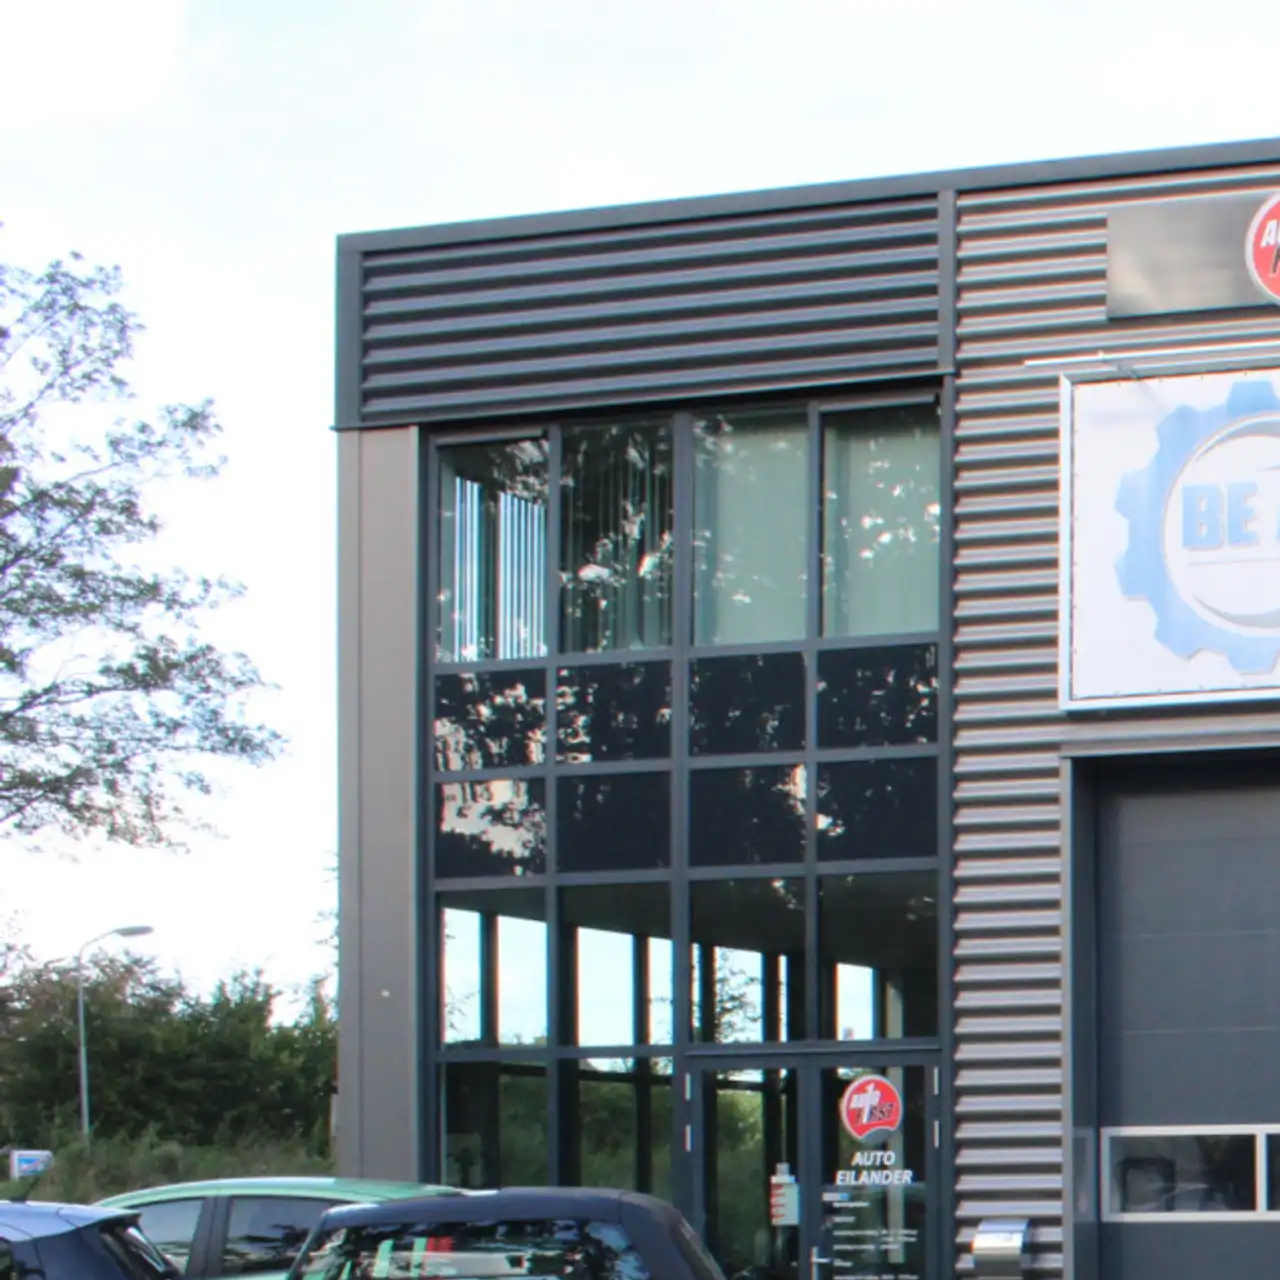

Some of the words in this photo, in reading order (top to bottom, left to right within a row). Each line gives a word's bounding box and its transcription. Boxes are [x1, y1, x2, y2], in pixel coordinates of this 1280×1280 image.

[1182, 480, 1259, 550] BE
[851, 1151, 895, 1167] AUTO
[836, 1170, 913, 1185] EILANDER
